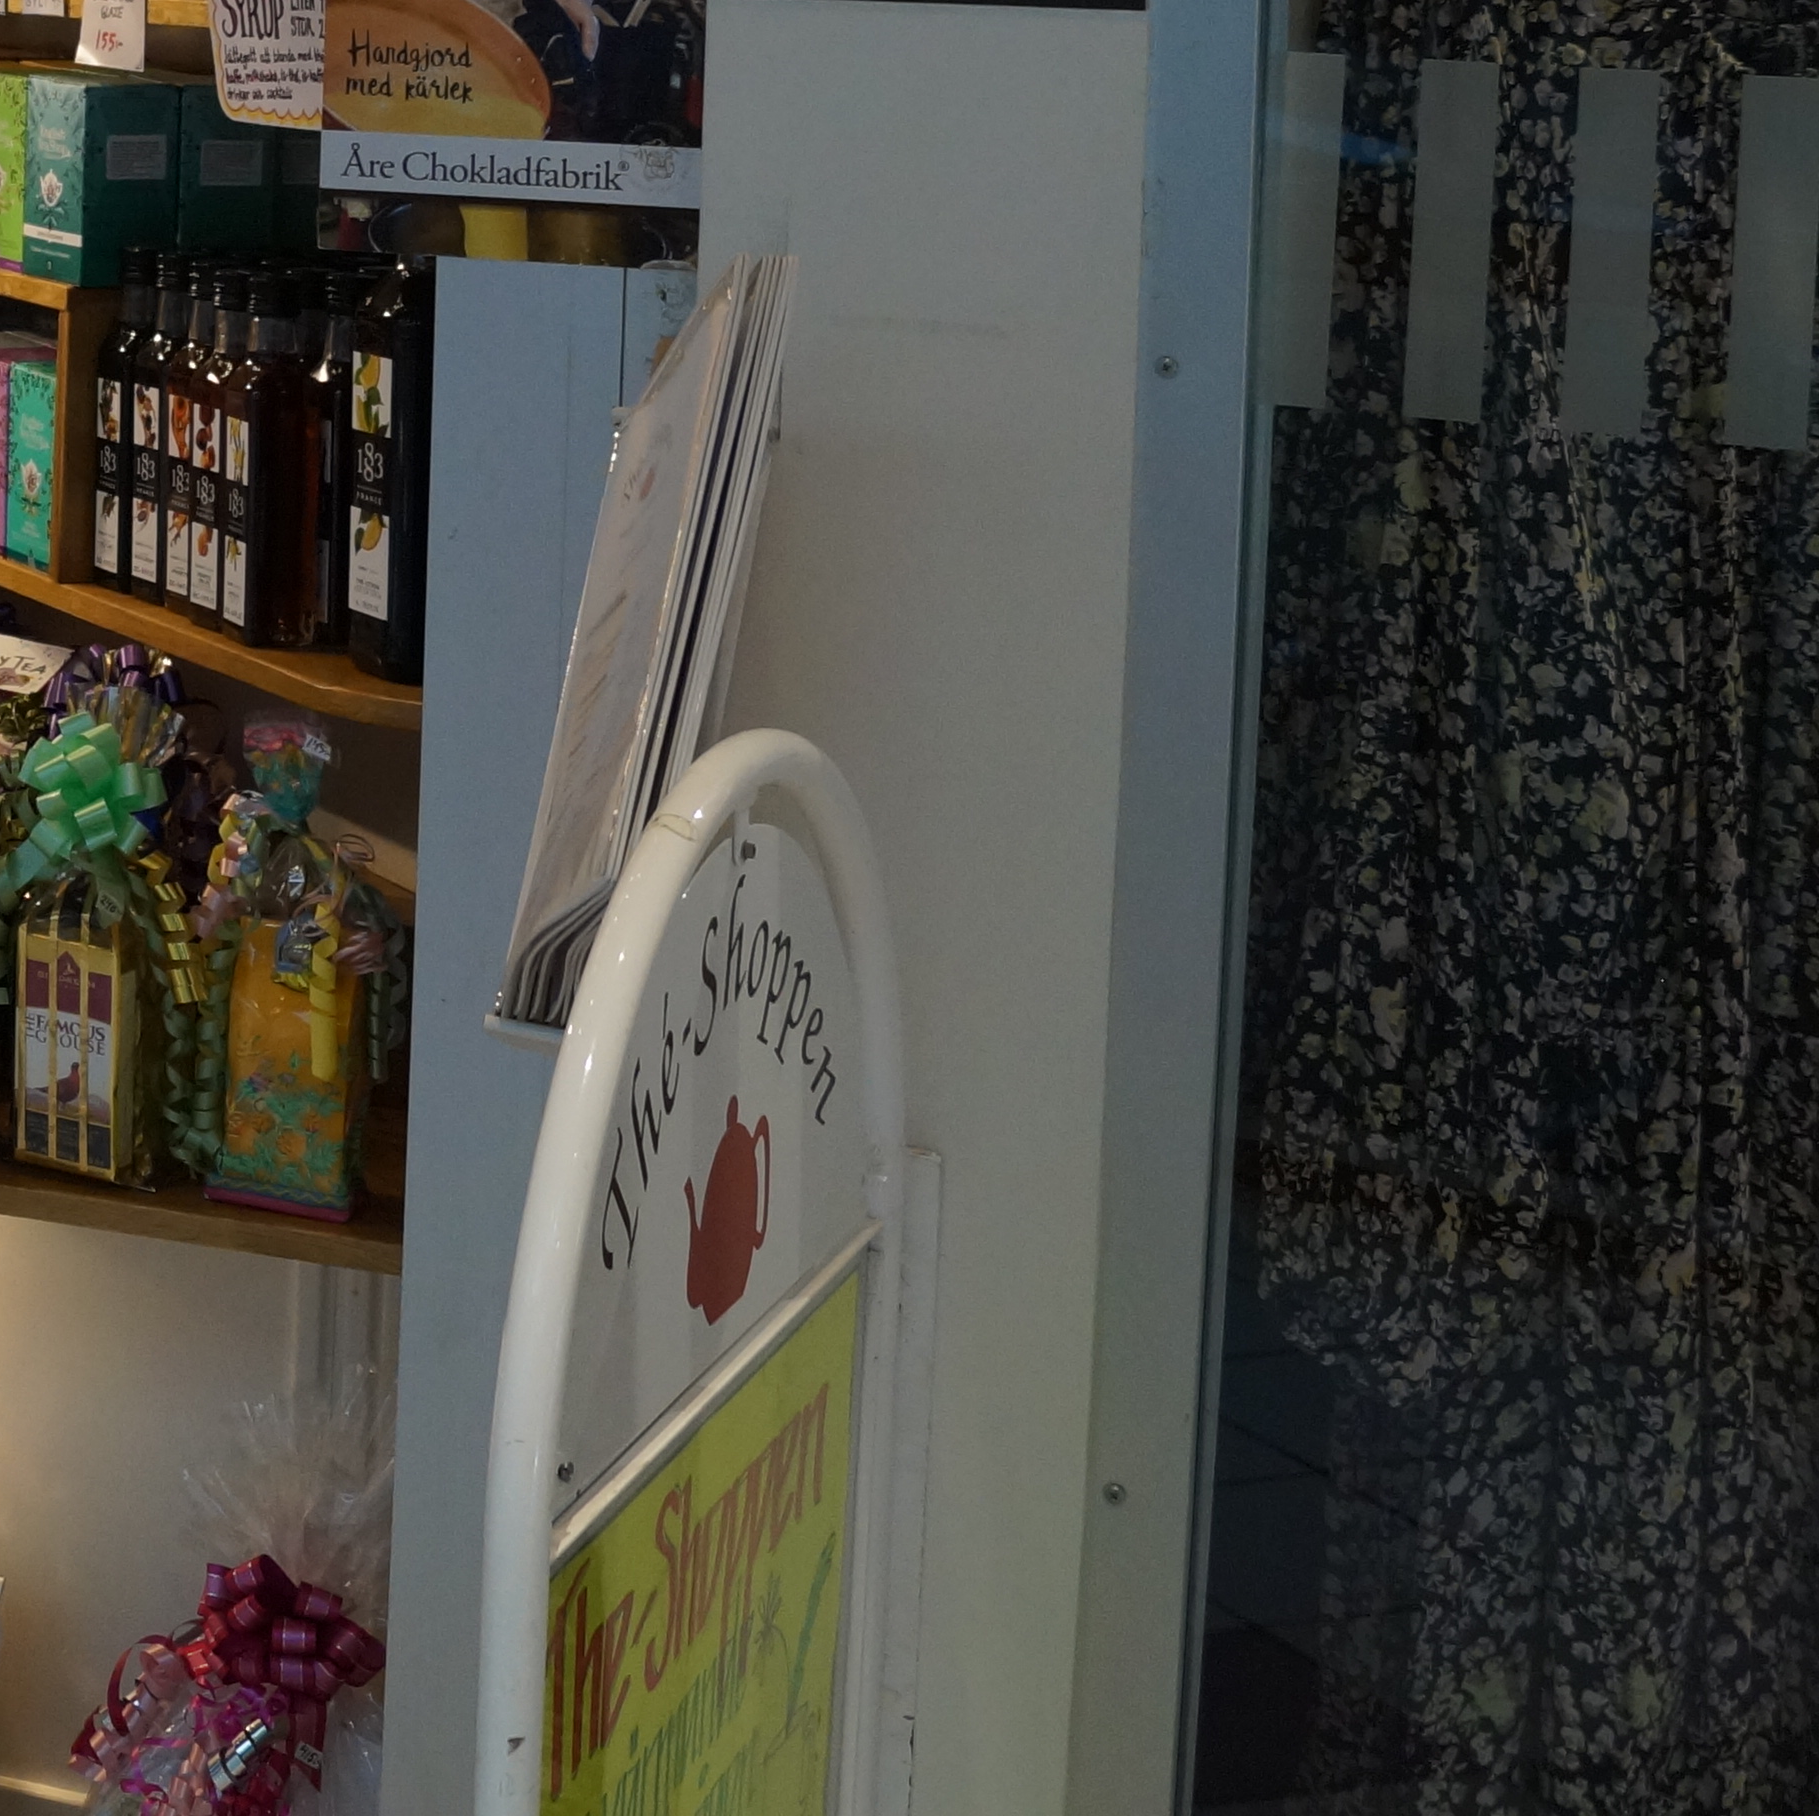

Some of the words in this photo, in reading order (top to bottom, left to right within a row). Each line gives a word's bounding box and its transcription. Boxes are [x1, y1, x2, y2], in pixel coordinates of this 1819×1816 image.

[346, 28, 473, 73] Handgjord
[344, 71, 394, 100] med
[404, 70, 474, 105] kärlek
[339, 141, 395, 182] Åre
[401, 148, 625, 192] Chokladfabrik
[34, 1028, 106, 1056] GOUSE
[602, 872, 841, 1274] Thé-Shoppen
